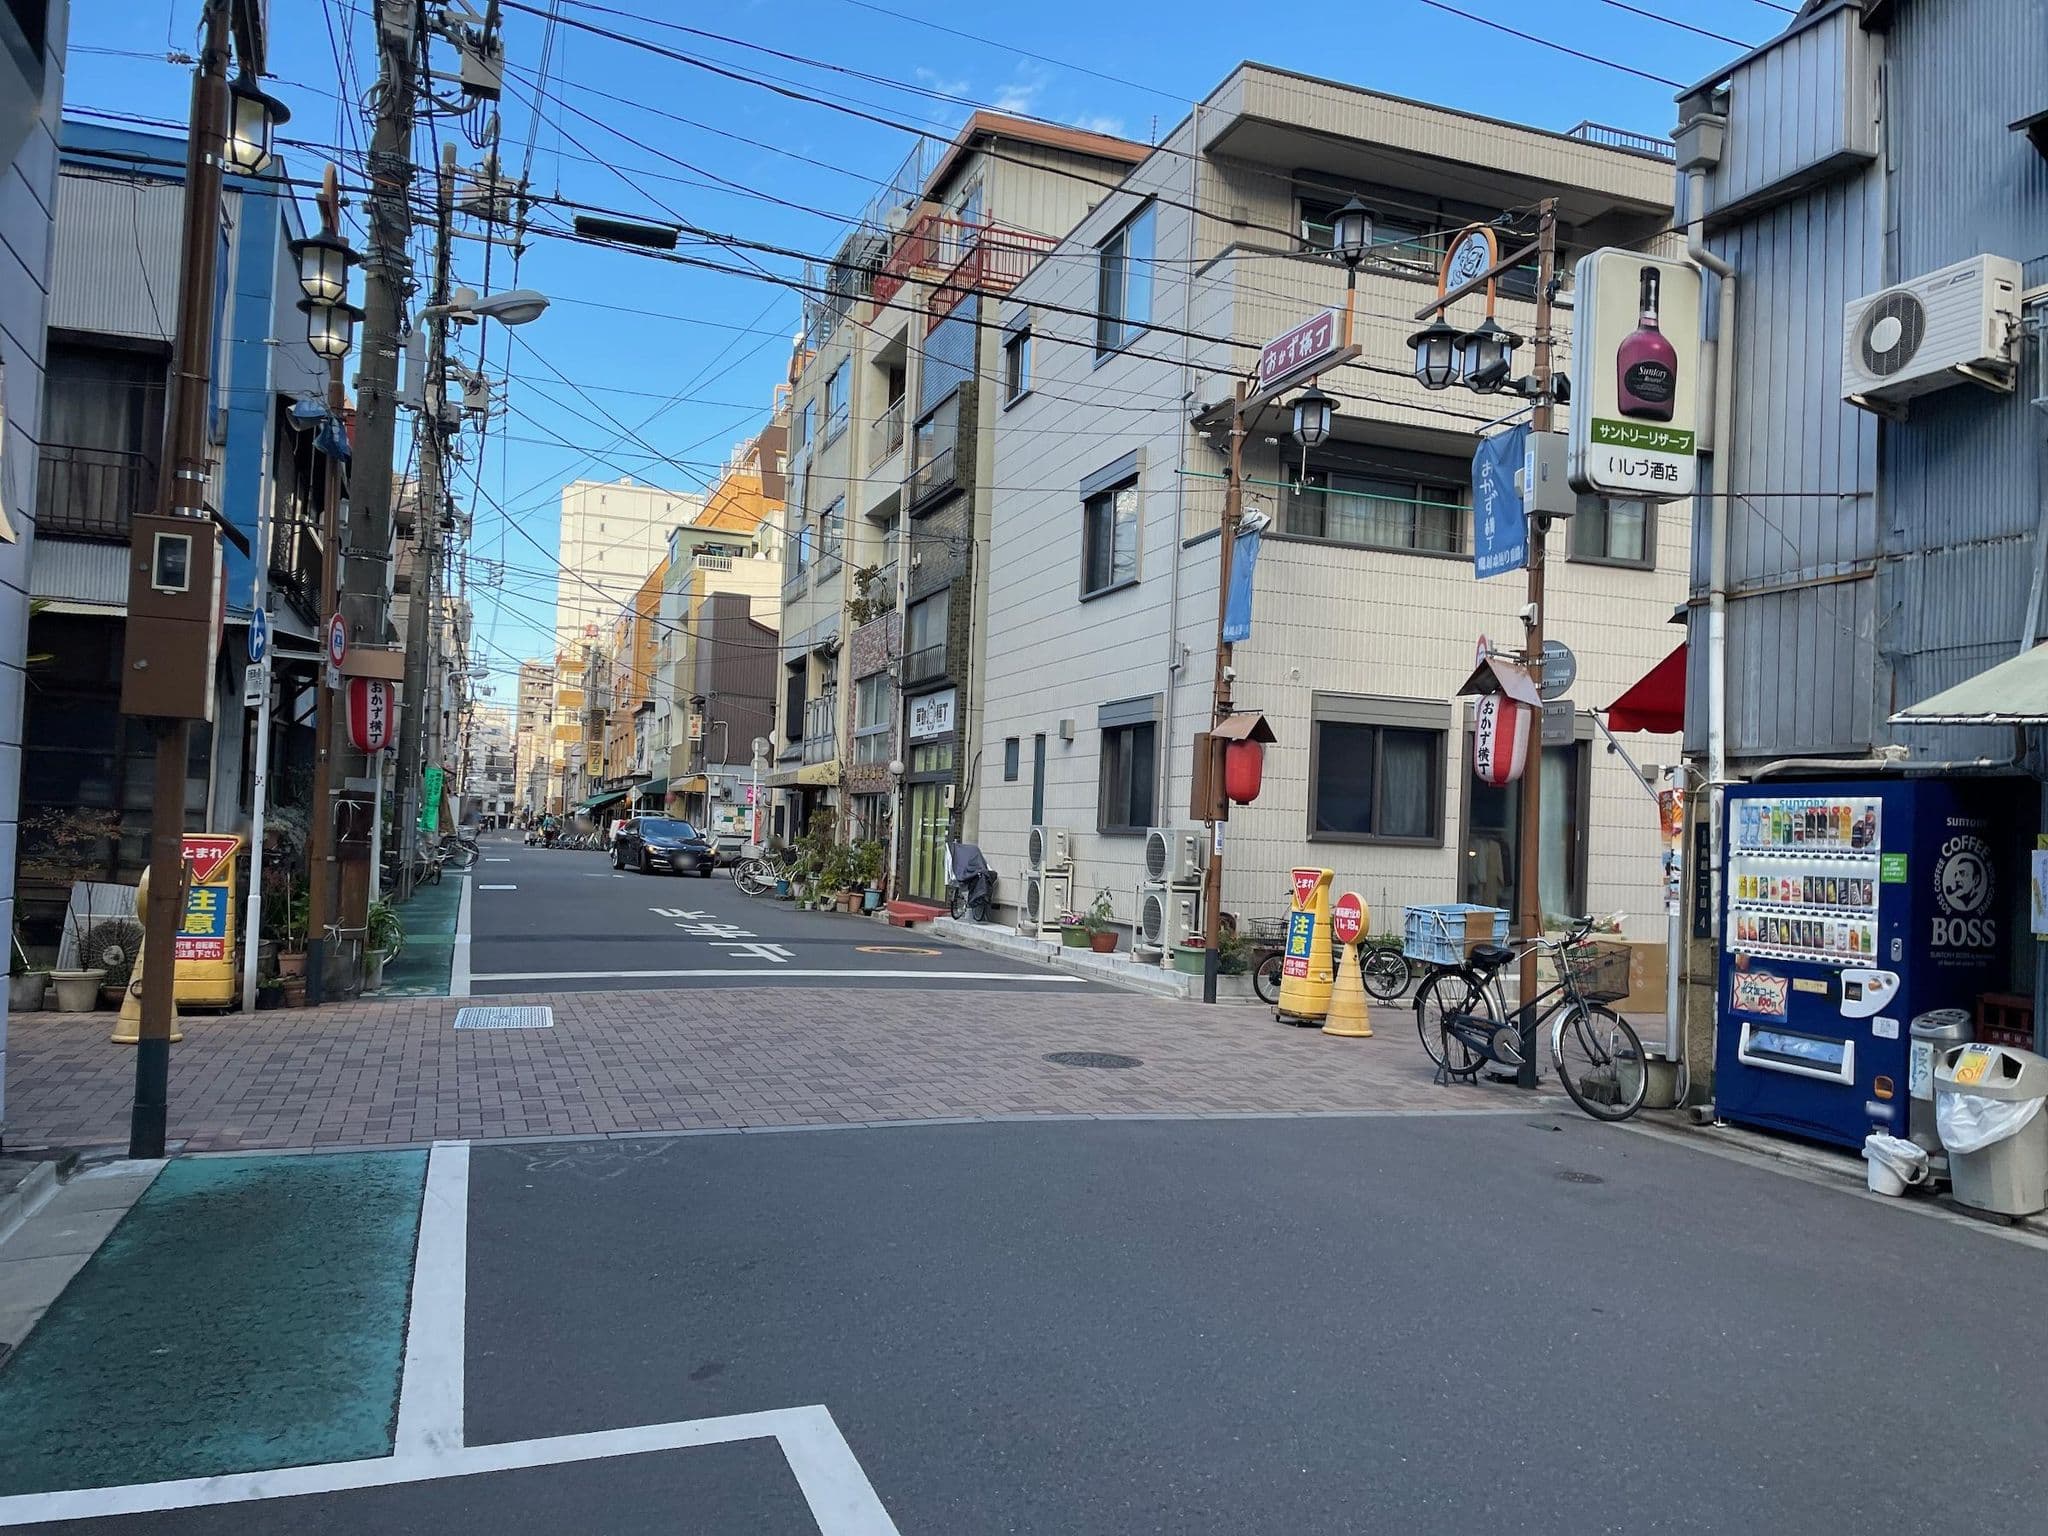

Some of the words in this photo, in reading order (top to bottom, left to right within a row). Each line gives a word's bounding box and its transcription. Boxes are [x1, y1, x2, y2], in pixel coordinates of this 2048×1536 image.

[1265, 324, 1328, 375] おかず横丁
[1639, 365, 1667, 380] Suntory
[1600, 424, 1691, 449] サントリーリザーブ
[1609, 456, 1678, 481] いしづ酒店
[1480, 459, 1498, 550] おかず横丁
[369, 681, 384, 744] おかず横丁
[1478, 701, 1495, 776] おかず横丁
[1780, 799, 1828, 810] SUNTORY
[1946, 816, 1988, 828] SUNTORY
[182, 847, 223, 859] とまれ
[1941, 834, 1991, 862] COFFEE
[1296, 879, 1314, 889] とまれ
[181, 889, 217, 935] 注意
[648, 907, 797, 962] 止まれ
[1291, 915, 1310, 955] 注意
[1931, 918, 1996, 947] BOSS
